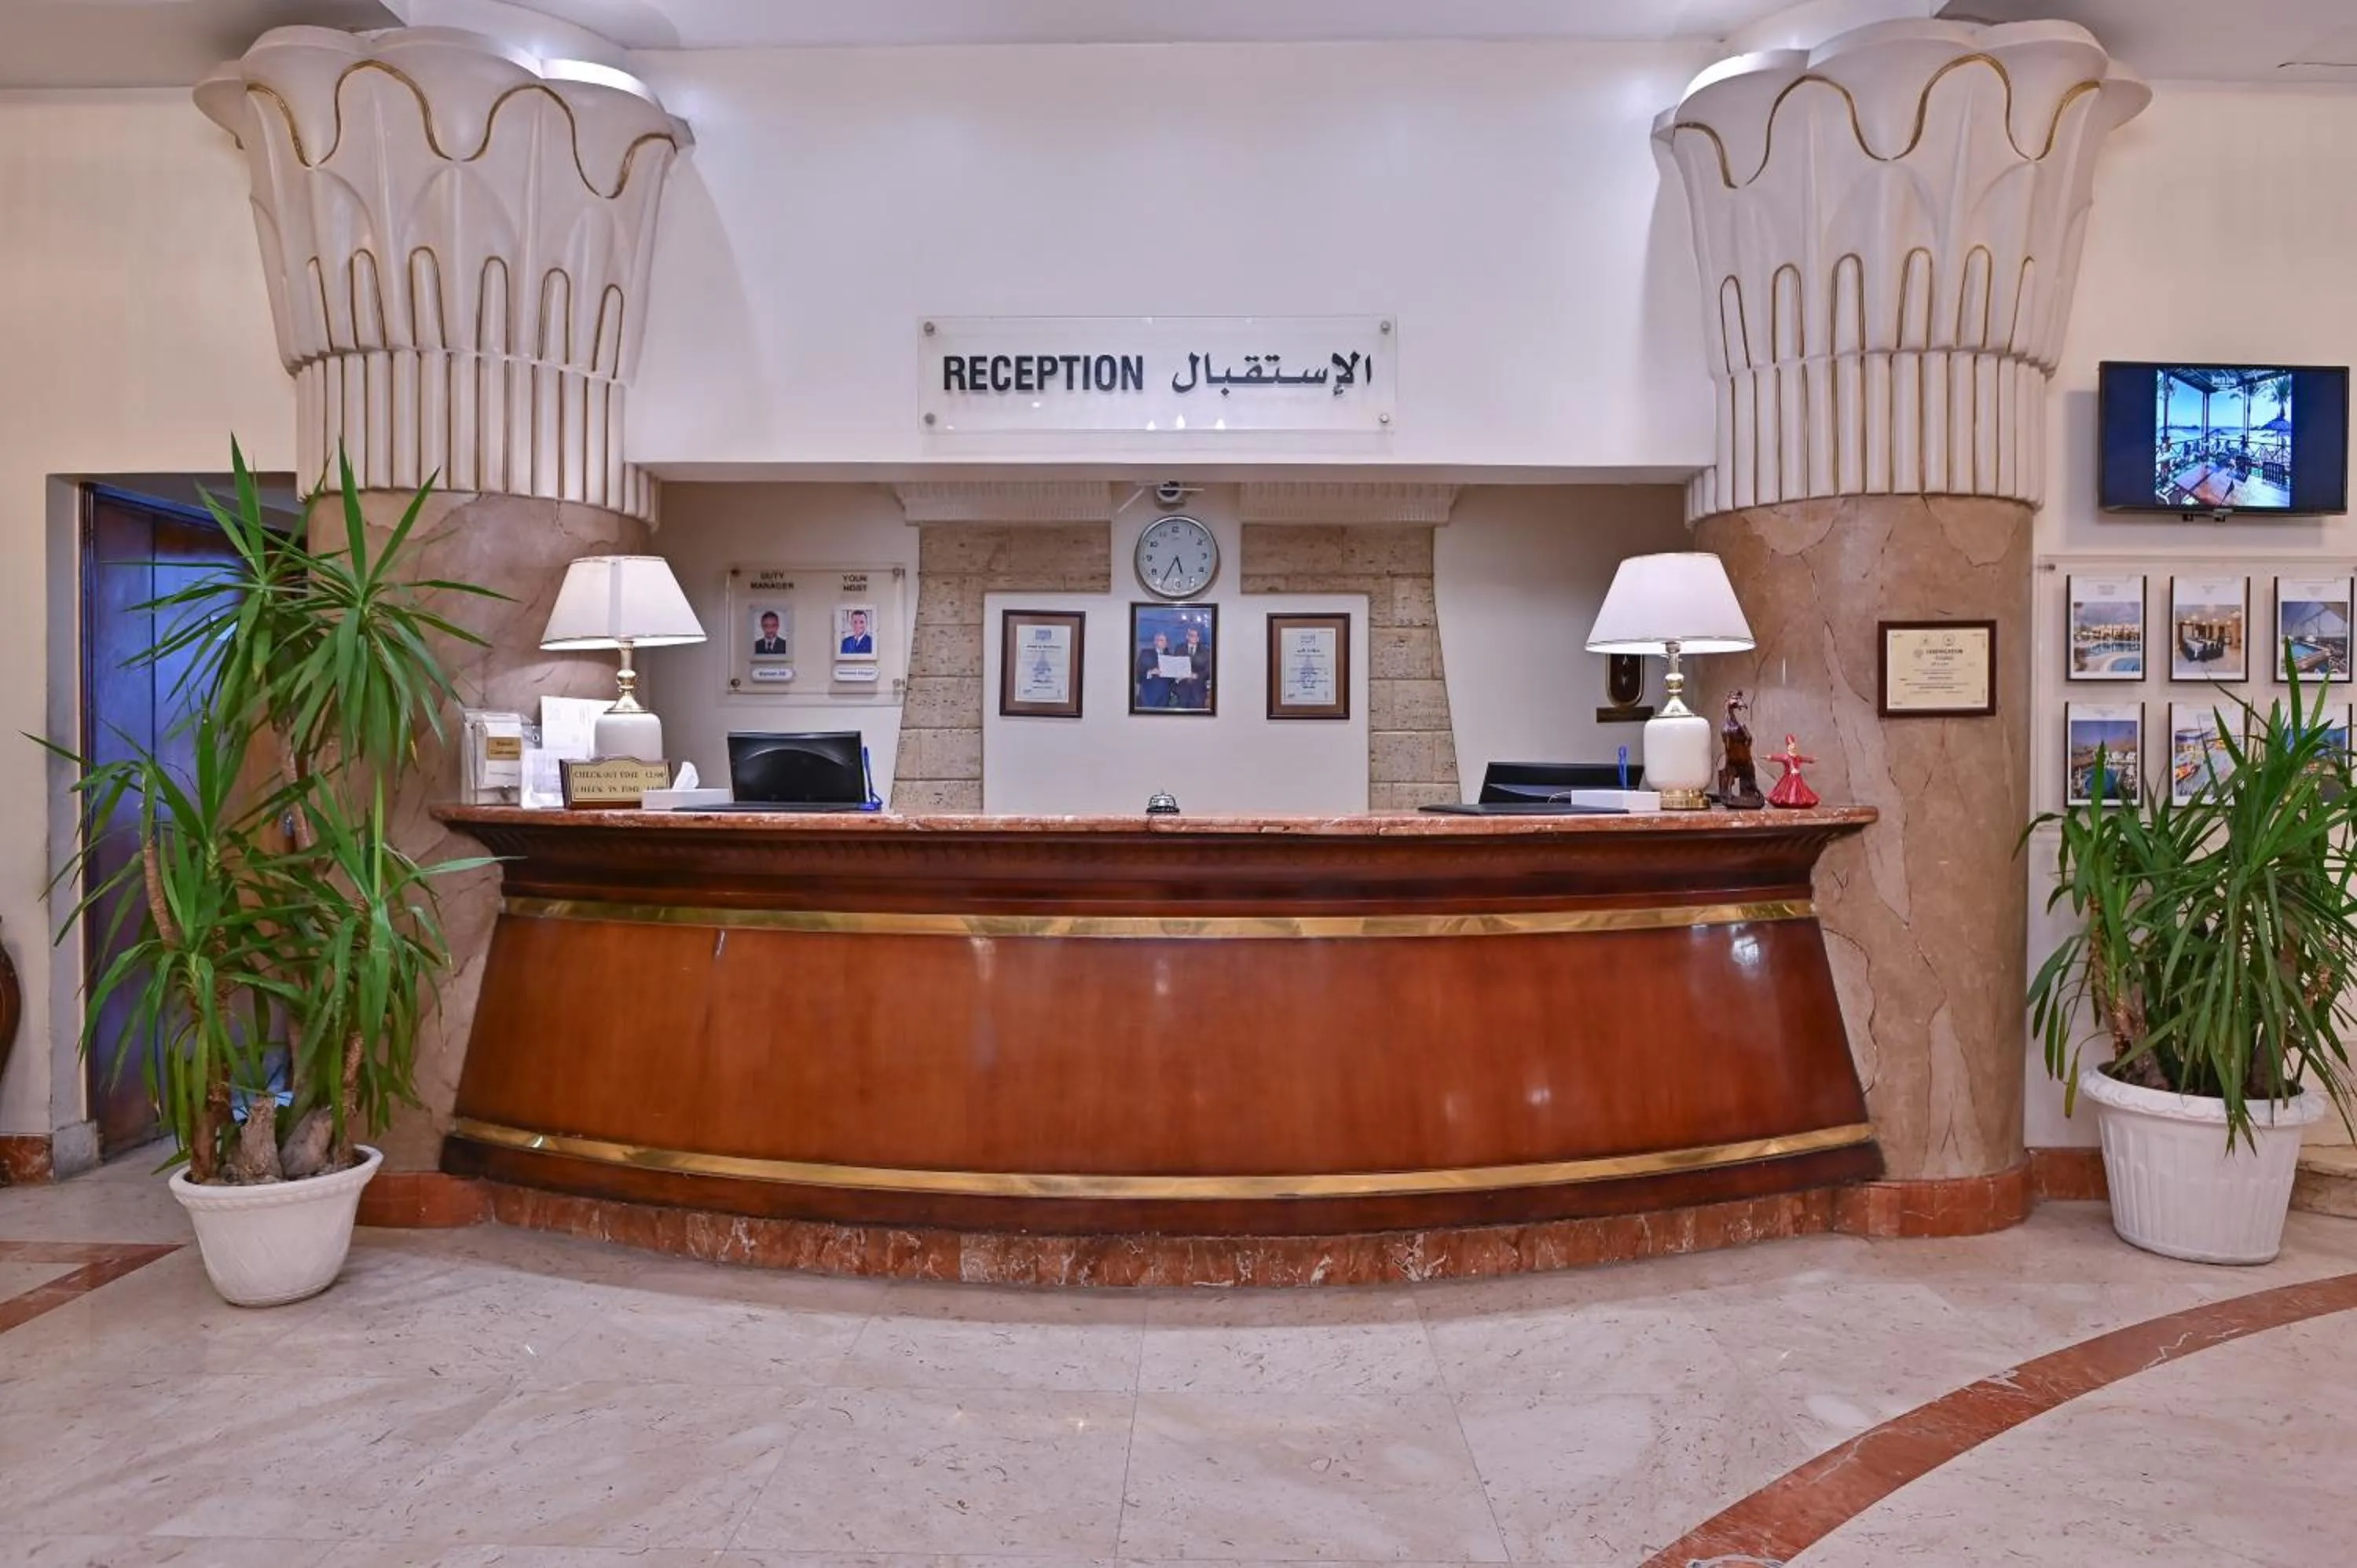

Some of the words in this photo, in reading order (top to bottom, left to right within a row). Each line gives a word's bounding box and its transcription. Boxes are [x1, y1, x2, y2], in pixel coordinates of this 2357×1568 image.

[942, 355, 1143, 392] RECEPTION
[1171, 351, 1372, 397] الإستقبال
[750, 581, 794, 590] MANAGER
[843, 584, 867, 592] HOST
